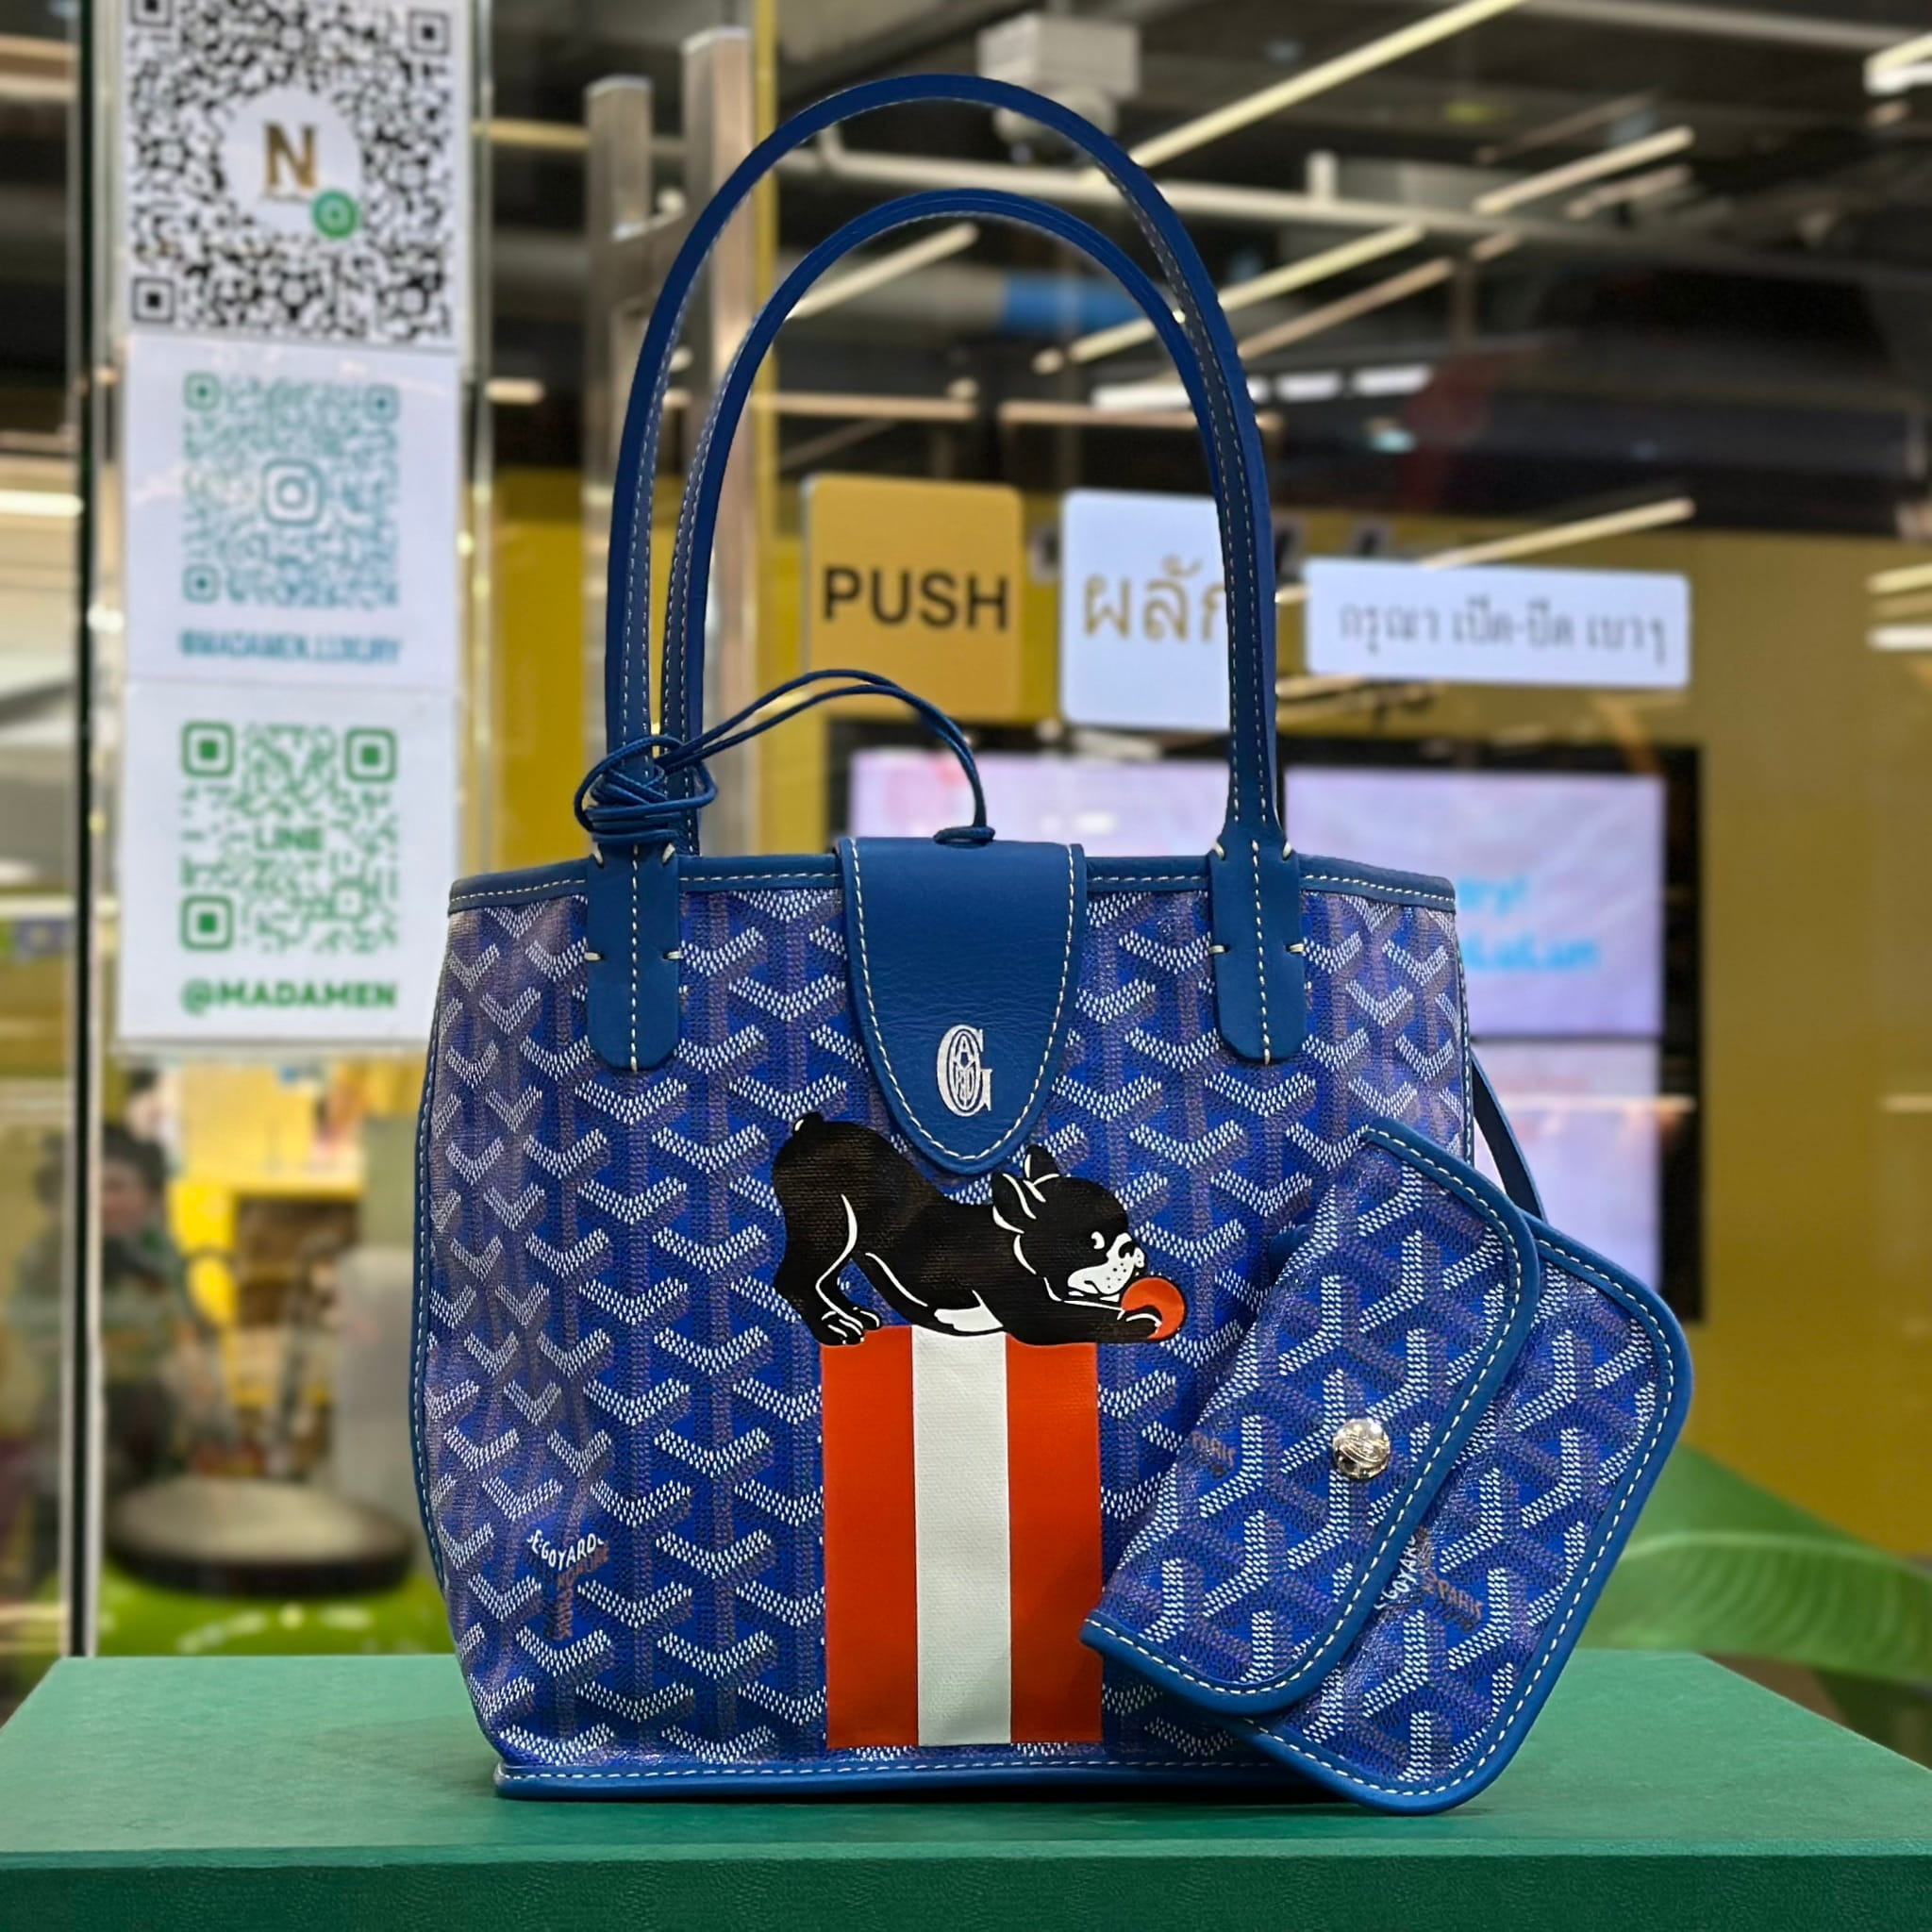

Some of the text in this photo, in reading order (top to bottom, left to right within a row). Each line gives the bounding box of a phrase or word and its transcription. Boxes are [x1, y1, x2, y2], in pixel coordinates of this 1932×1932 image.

[265, 124, 316, 188] N
[823, 566, 1008, 632] PUSH
[182, 978, 397, 1016] @MADAMEN
